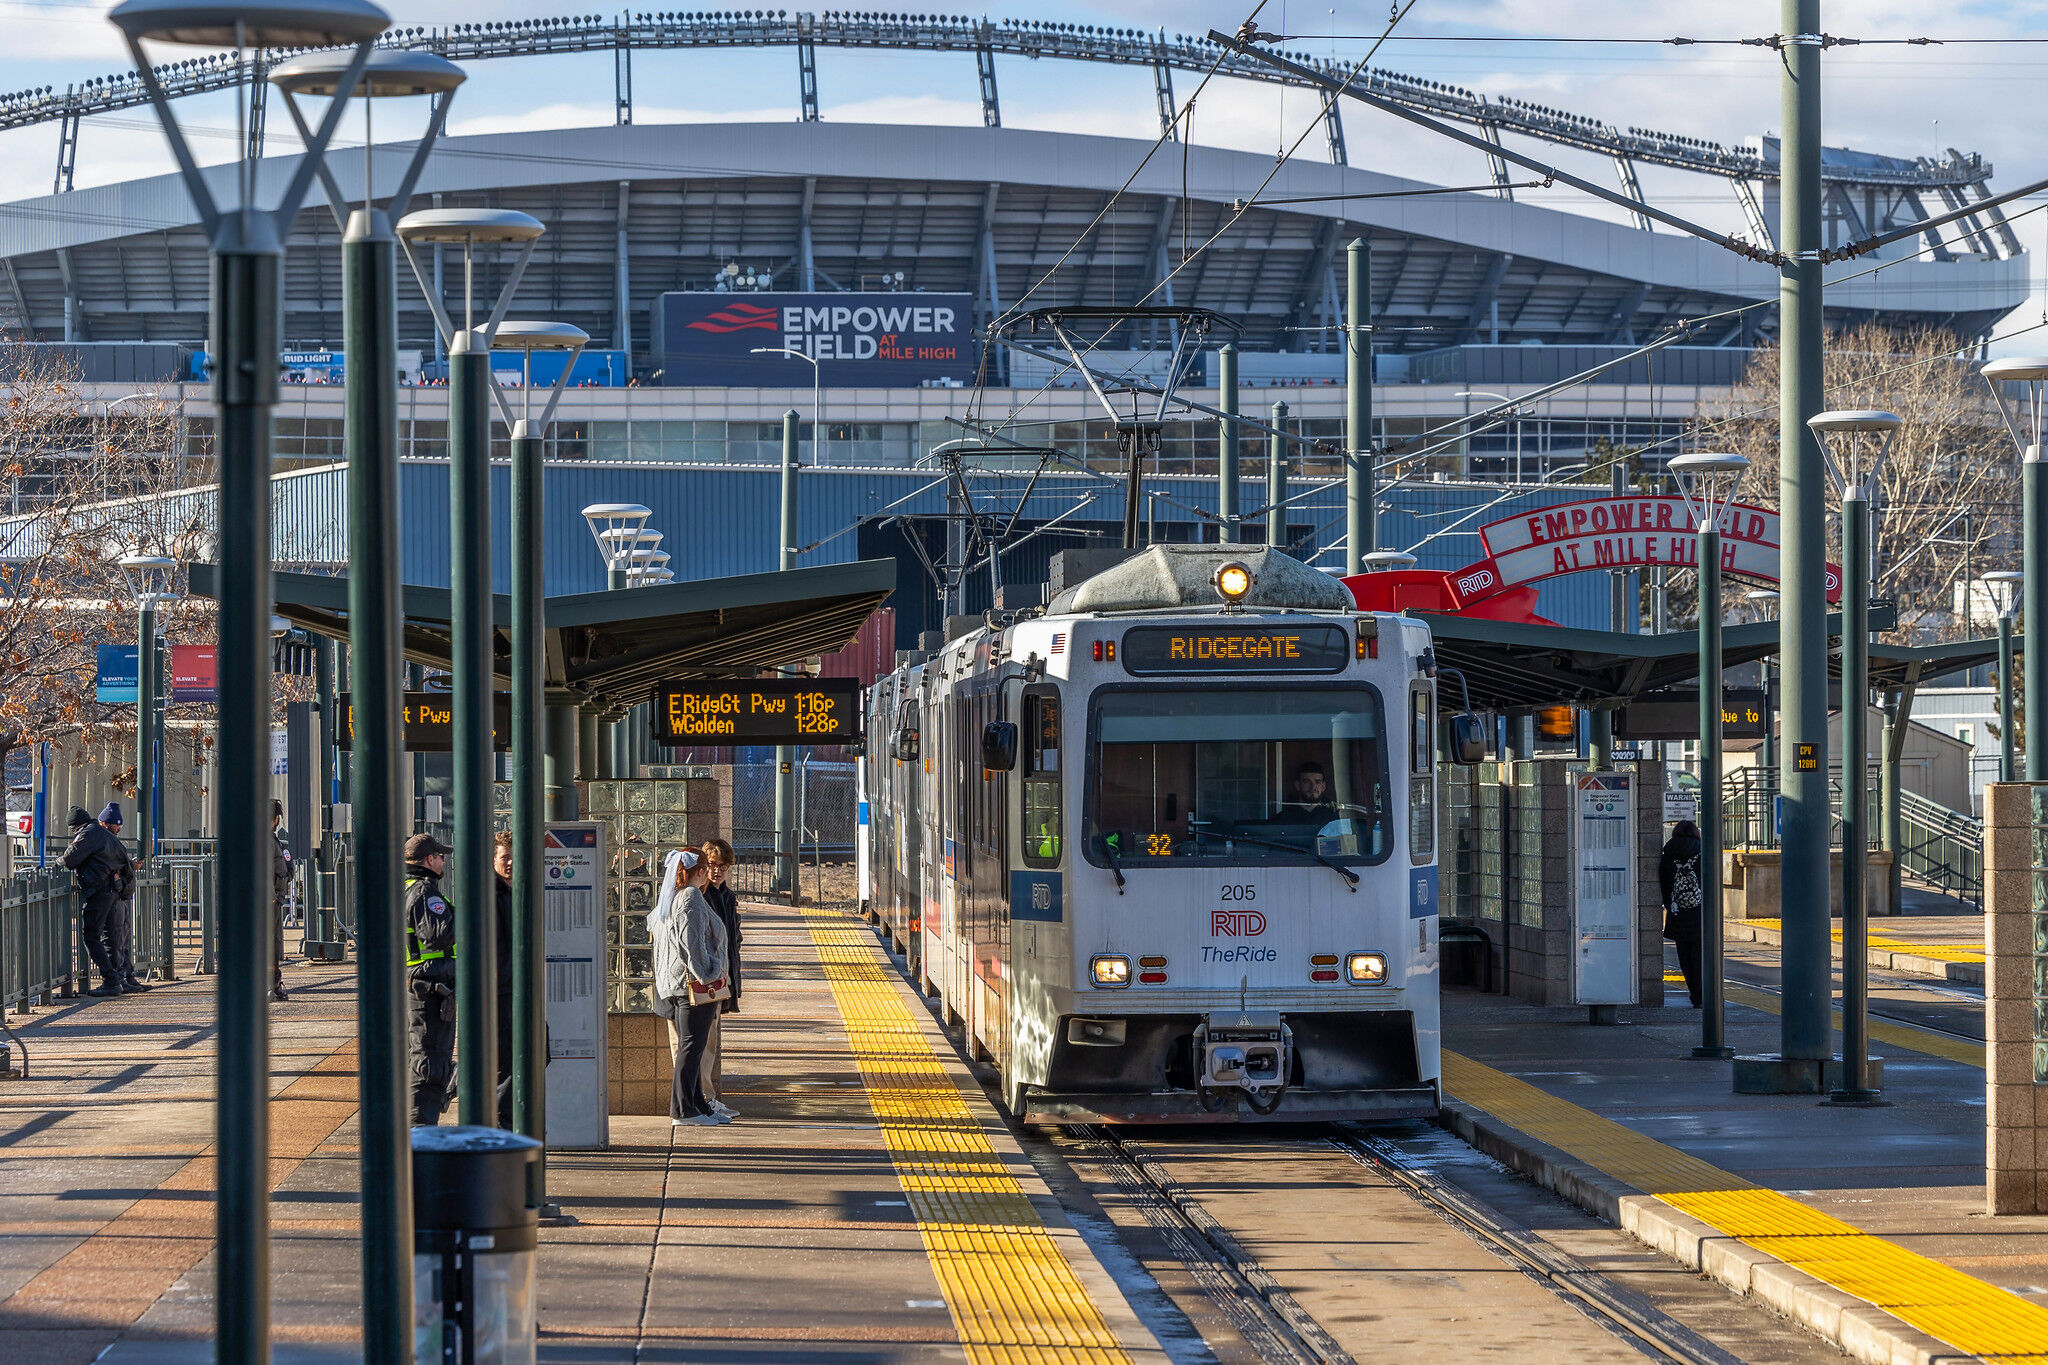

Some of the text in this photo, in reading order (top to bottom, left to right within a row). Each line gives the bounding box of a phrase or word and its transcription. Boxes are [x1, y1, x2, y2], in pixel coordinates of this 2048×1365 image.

[783, 306, 955, 333] EMPOWER
[783, 334, 878, 359] FIELD
[879, 335, 898, 347] AT
[284, 354, 331, 363] BUD LIGHT
[879, 347, 956, 359] MILE HIGH
[1528, 501, 1672, 544] EMPOWER
[1554, 537, 1737, 573] AT MILE HIH
[1457, 569, 1494, 597] RTD
[1171, 636, 1300, 659] RIDGEGATE
[751, 693, 786, 713] Pwy
[794, 692, 835, 713] 1:16p
[420, 706, 451, 724] Pwy
[794, 712, 839, 733] 1:28p
[1745, 708, 1759, 723] to
[1799, 745, 1812, 756] CPV
[1147, 834, 1171, 855] 32
[1220, 884, 1256, 901] 205
[1210, 910, 1267, 937] RTD
[1201, 945, 1277, 963] TheRide
